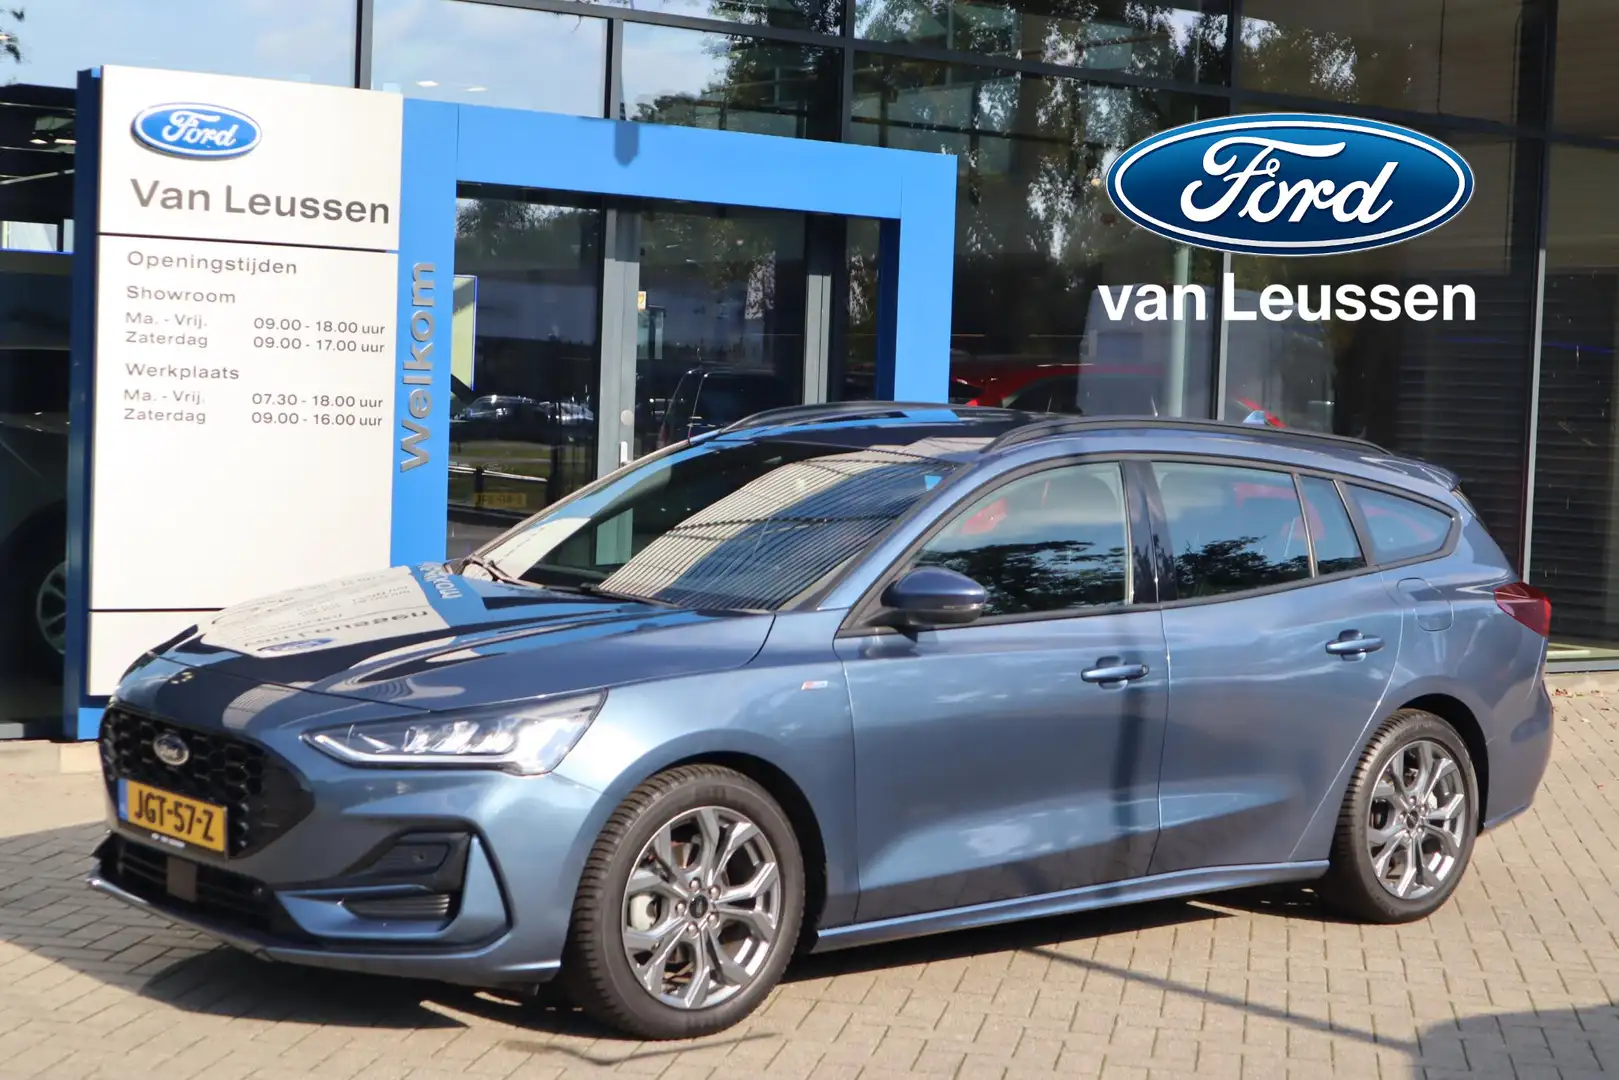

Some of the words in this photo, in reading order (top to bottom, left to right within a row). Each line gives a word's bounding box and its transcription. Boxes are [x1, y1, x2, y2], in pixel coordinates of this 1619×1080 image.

[161, 109, 239, 148] Ford
[130, 178, 211, 212] Van
[225, 184, 390, 225] Leussen
[127, 250, 297, 276] Openingstijden
[126, 285, 236, 304] Showroom
[125, 311, 159, 325] Ma.
[174, 314, 208, 330] Vrij.
[253, 317, 302, 332] 09.00
[316, 320, 358, 334] 18.00
[361, 325, 386, 335] uur
[125, 330, 208, 349] Zaterdag
[253, 336, 302, 350] 09.00
[316, 339, 357, 352] 17.00
[360, 343, 385, 353] uur
[125, 363, 240, 381] Werkplaats
[400, 262, 436, 473] Welkom
[124, 389, 157, 402] Ma.
[251, 392, 298, 406] 07.30
[312, 395, 356, 408] 18.00
[359, 399, 384, 409] uur
[123, 407, 206, 425] Zaterdag
[251, 411, 300, 425] 09.00
[313, 413, 356, 427] 16.00
[359, 417, 384, 427] uur
[134, 789, 215, 843] JGT-57-Z
